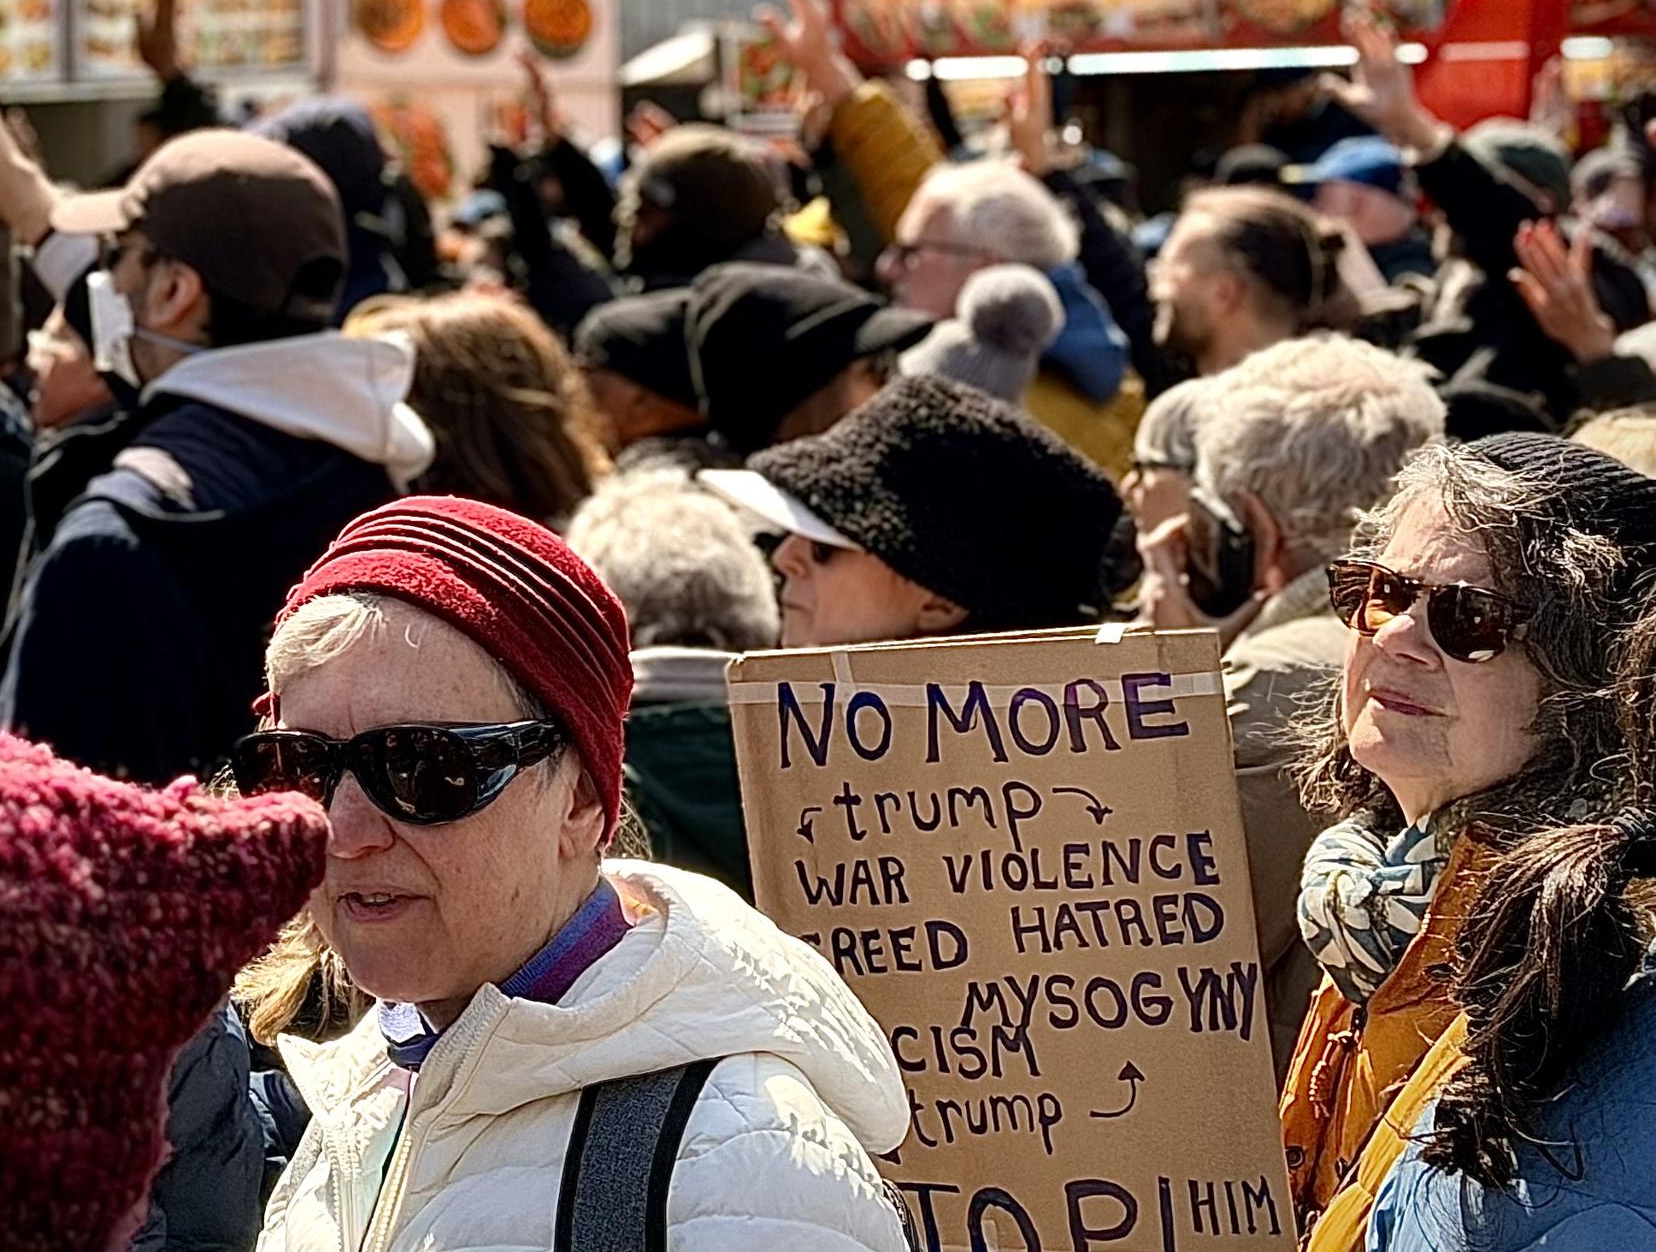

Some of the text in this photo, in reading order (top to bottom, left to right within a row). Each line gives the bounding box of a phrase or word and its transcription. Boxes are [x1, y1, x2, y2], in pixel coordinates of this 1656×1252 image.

[777, 671, 1190, 769] NO MORE
[832, 781, 1043, 853] trump
[794, 829, 1221, 907] WAR VIOLENCE
[800, 891, 1225, 976] REED HATRED
[959, 960, 1258, 1042] MYSOGYNY
[889, 1024, 1041, 1080] CISM
[908, 1088, 1063, 1156] trump
[1187, 1175, 1282, 1237] HIM
